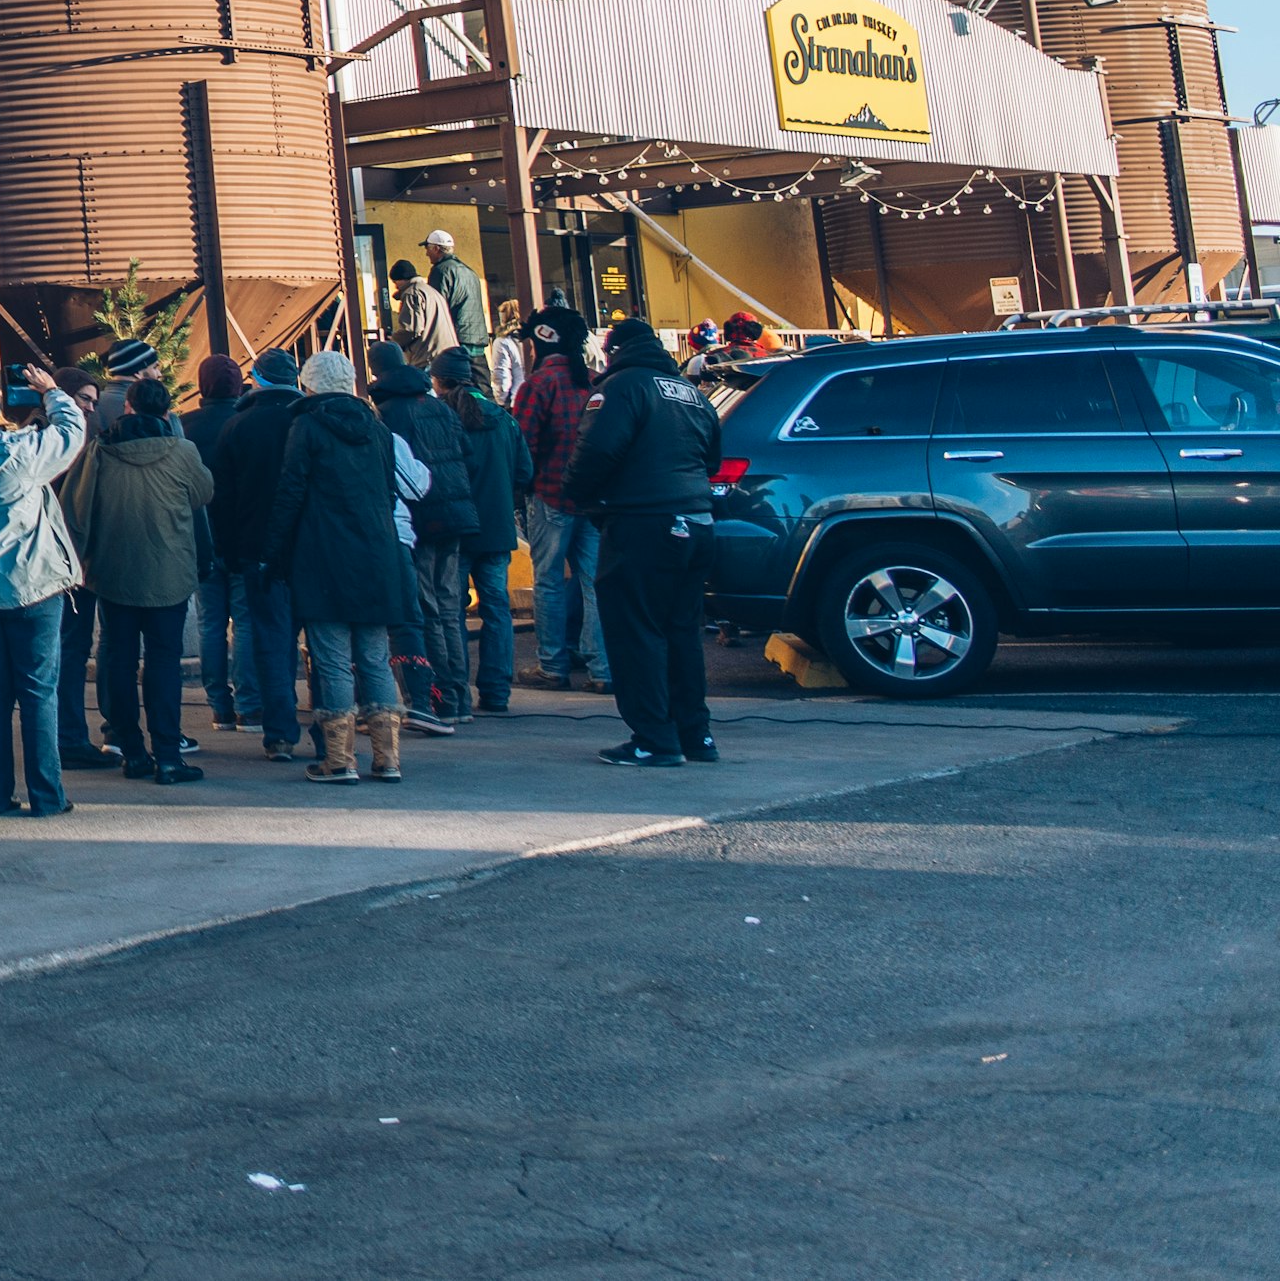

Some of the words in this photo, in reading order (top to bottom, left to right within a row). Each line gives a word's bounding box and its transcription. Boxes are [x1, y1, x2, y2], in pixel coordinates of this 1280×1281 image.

[816, 12, 858, 31] COLORADO
[862, 15, 897, 41] WHISKEY
[784, 13, 917, 84] Stranahan's
[658, 379, 700, 405] SECURITY
